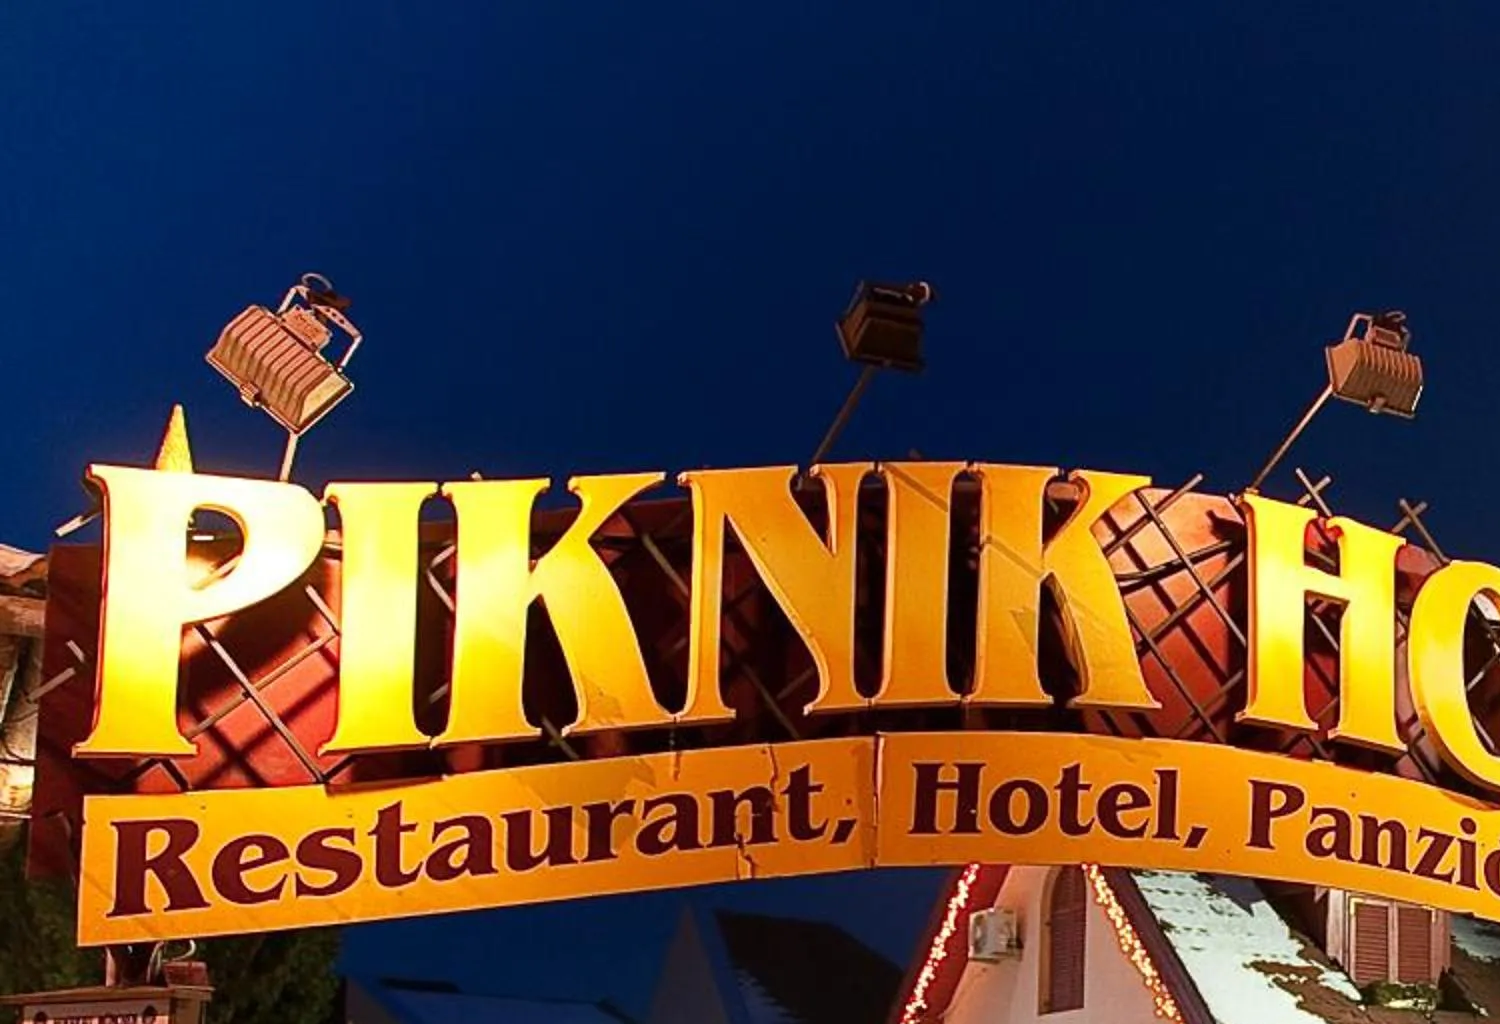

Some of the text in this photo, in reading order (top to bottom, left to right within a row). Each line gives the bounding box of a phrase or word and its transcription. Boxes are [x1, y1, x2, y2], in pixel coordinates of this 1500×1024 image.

[73, 460, 1162, 758] PIKNIK
[105, 764, 858, 918] Restaurant,
[908, 761, 1208, 849] Hotel,
